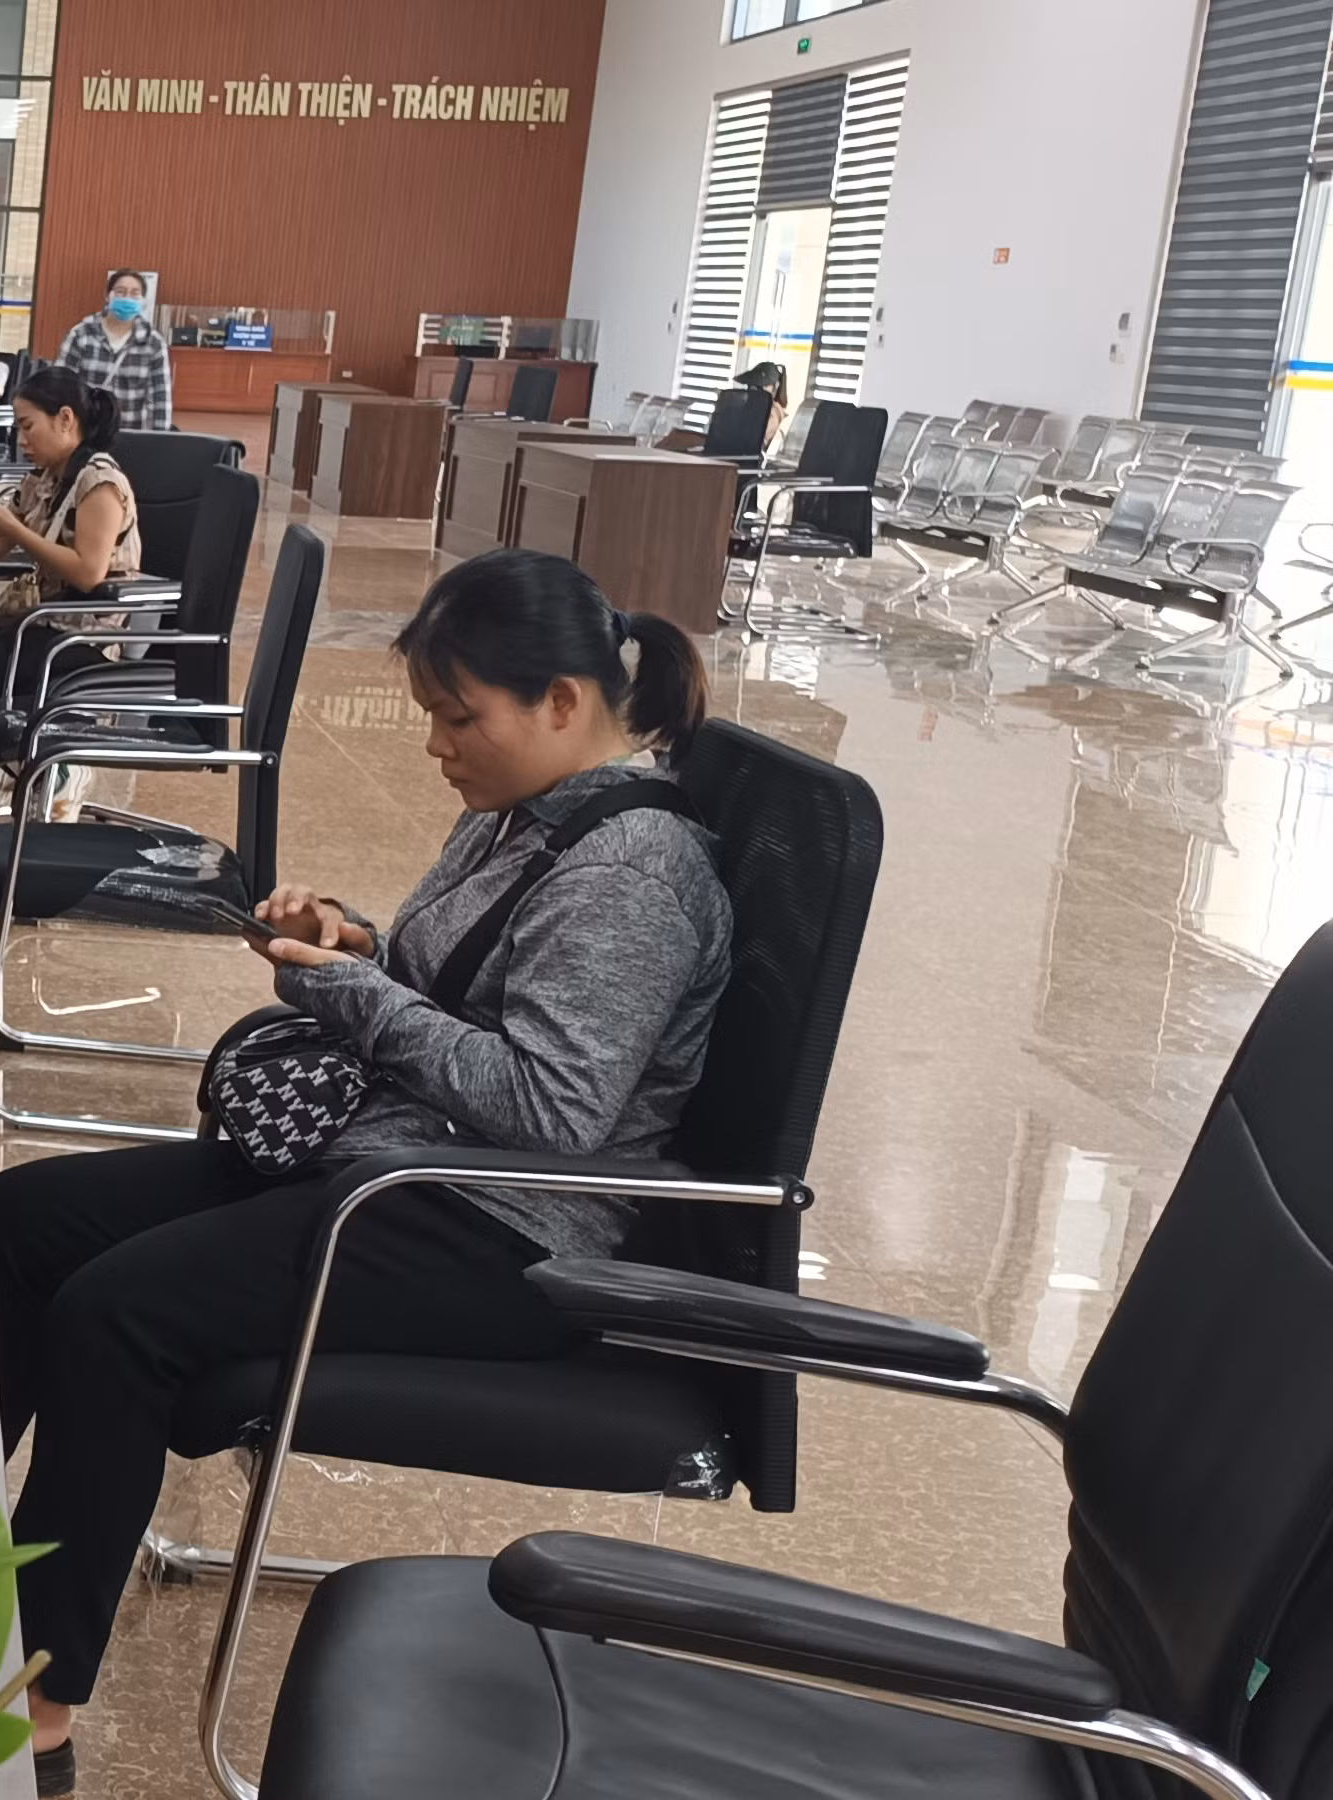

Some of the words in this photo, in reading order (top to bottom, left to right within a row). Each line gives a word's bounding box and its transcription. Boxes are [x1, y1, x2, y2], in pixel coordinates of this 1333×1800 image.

[82, 70, 132, 112] VĂN
[136, 78, 204, 115] MINH
[224, 74, 290, 117] THÂN
[298, 75, 373, 126] THIỆN
[392, 76, 475, 121] TRÁCH
[479, 78, 569, 131] NHIỆM
